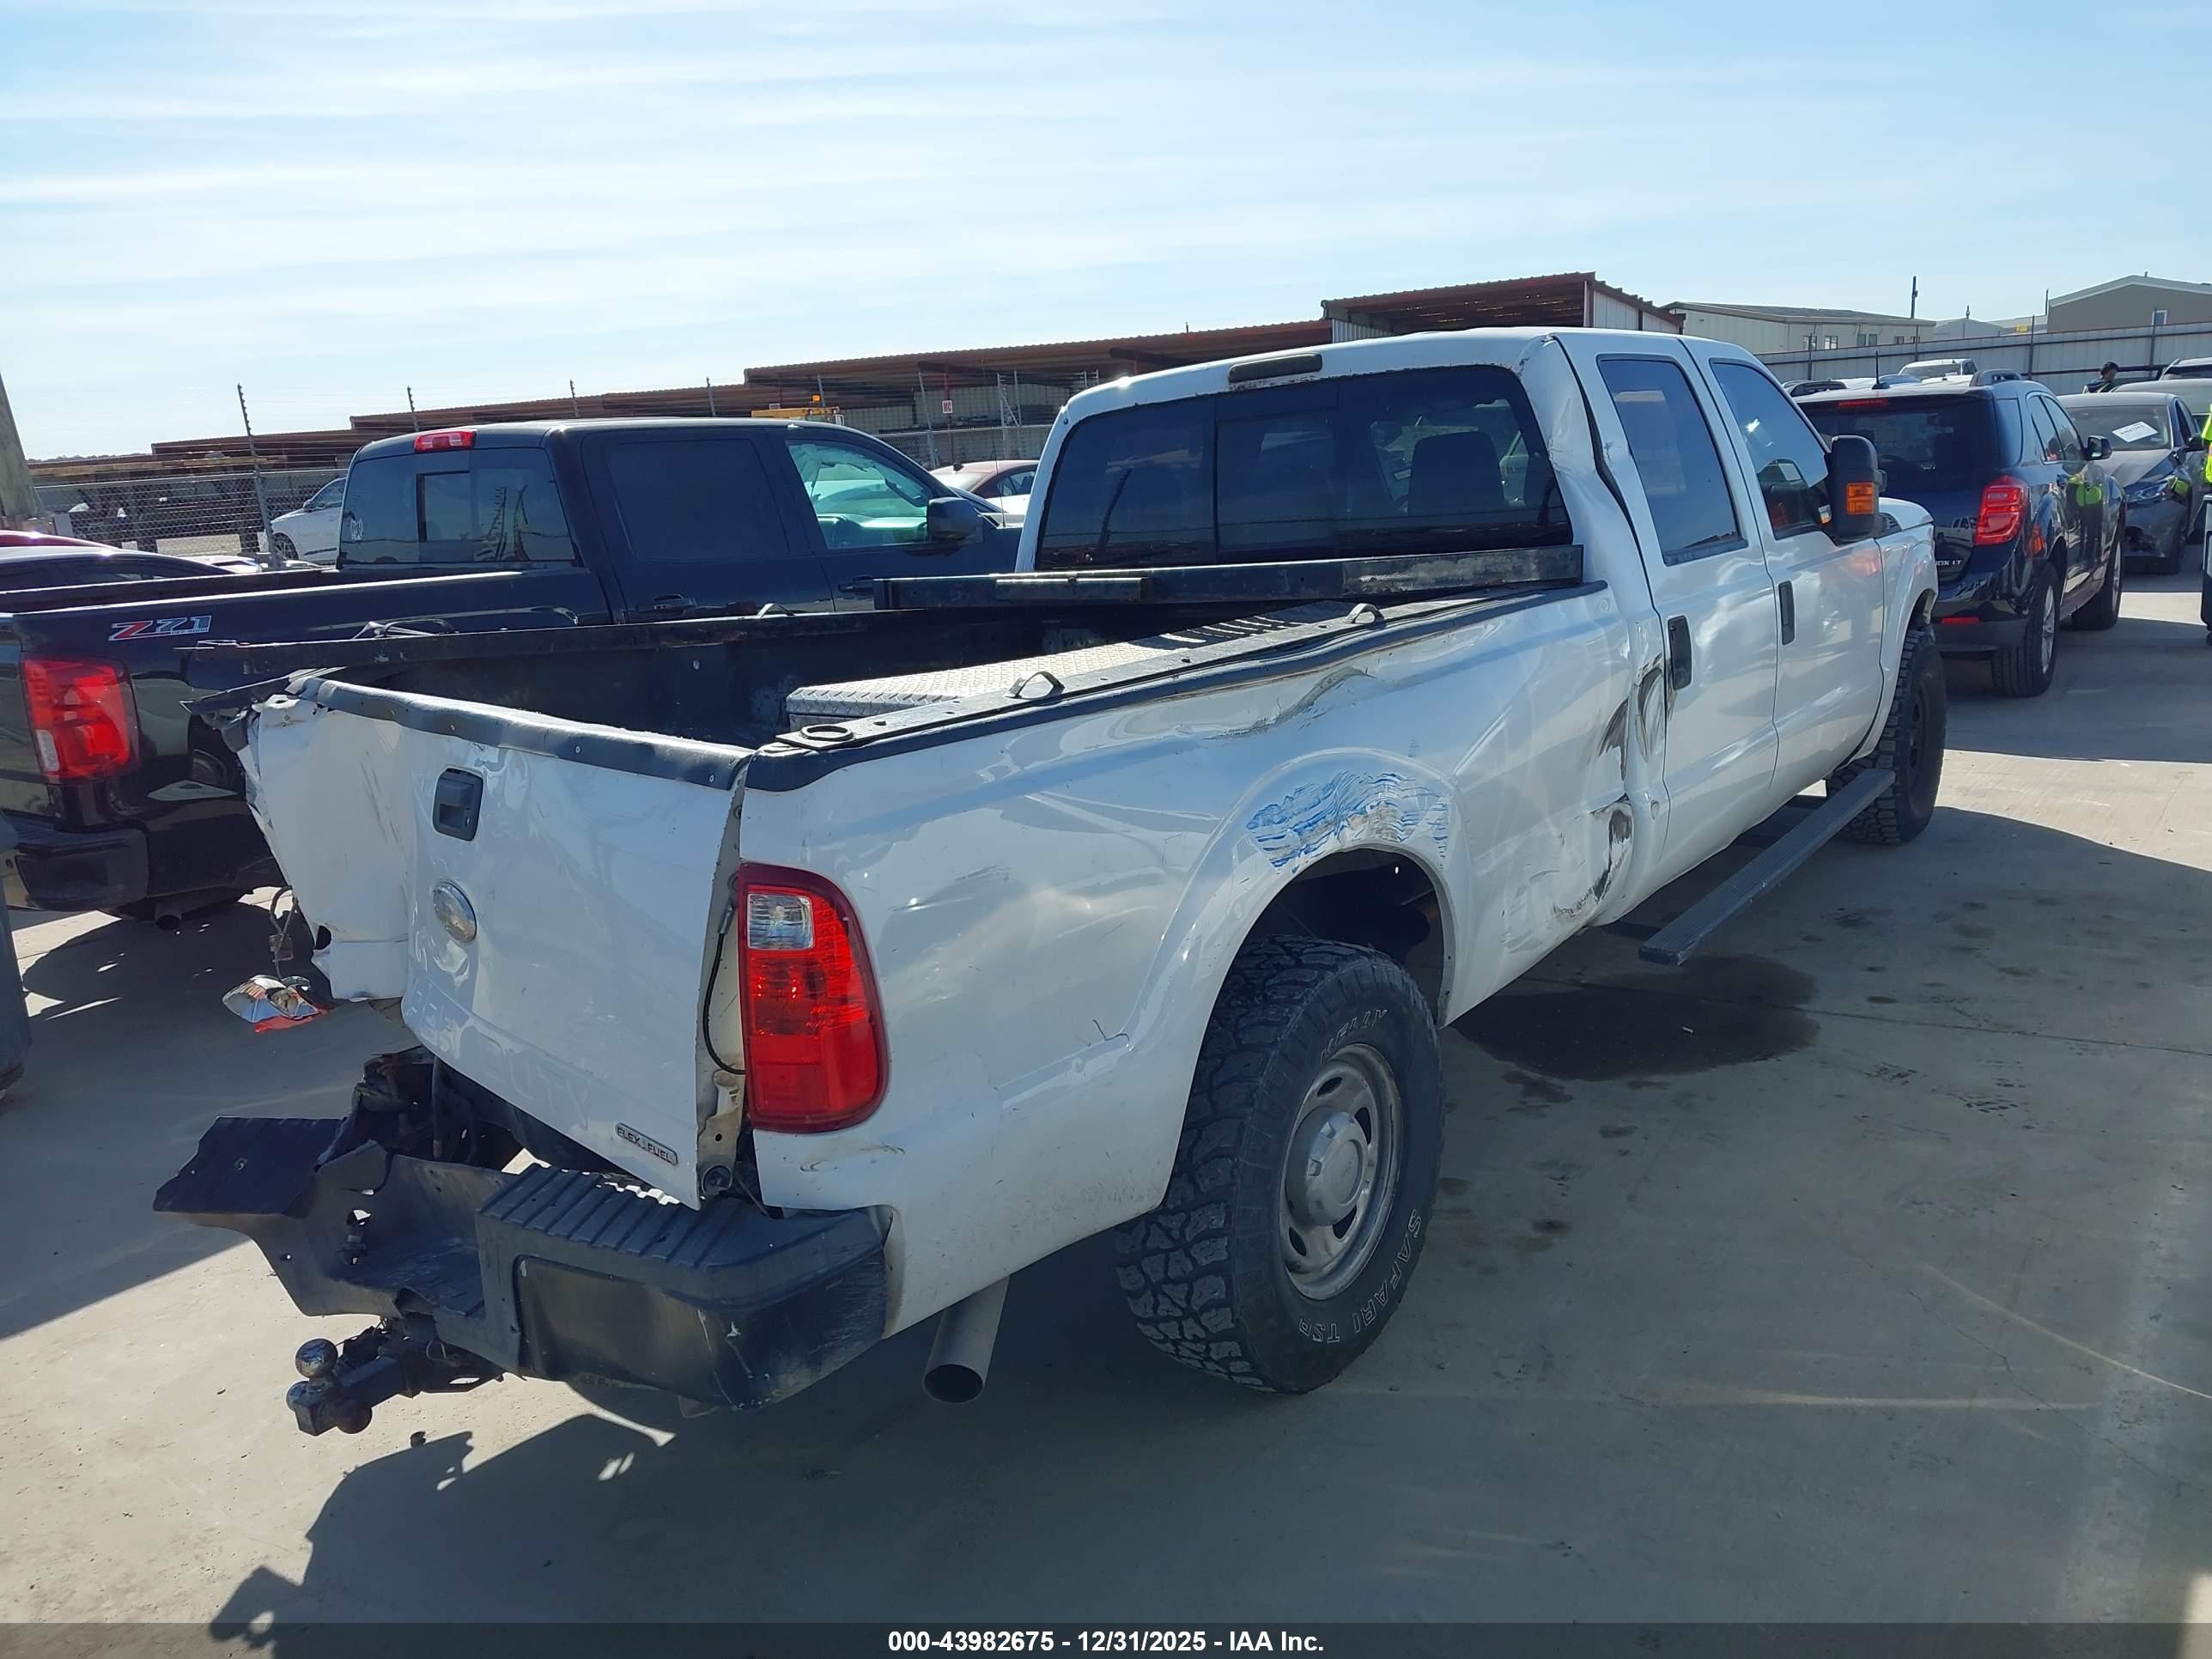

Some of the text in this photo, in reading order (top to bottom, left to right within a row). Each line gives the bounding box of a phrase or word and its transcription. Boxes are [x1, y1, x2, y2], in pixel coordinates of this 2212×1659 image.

[108, 616, 212, 641] Z71
[617, 1126, 676, 1165] FLEX FUEL
[1351, 1208, 1422, 1334] SAFARI
